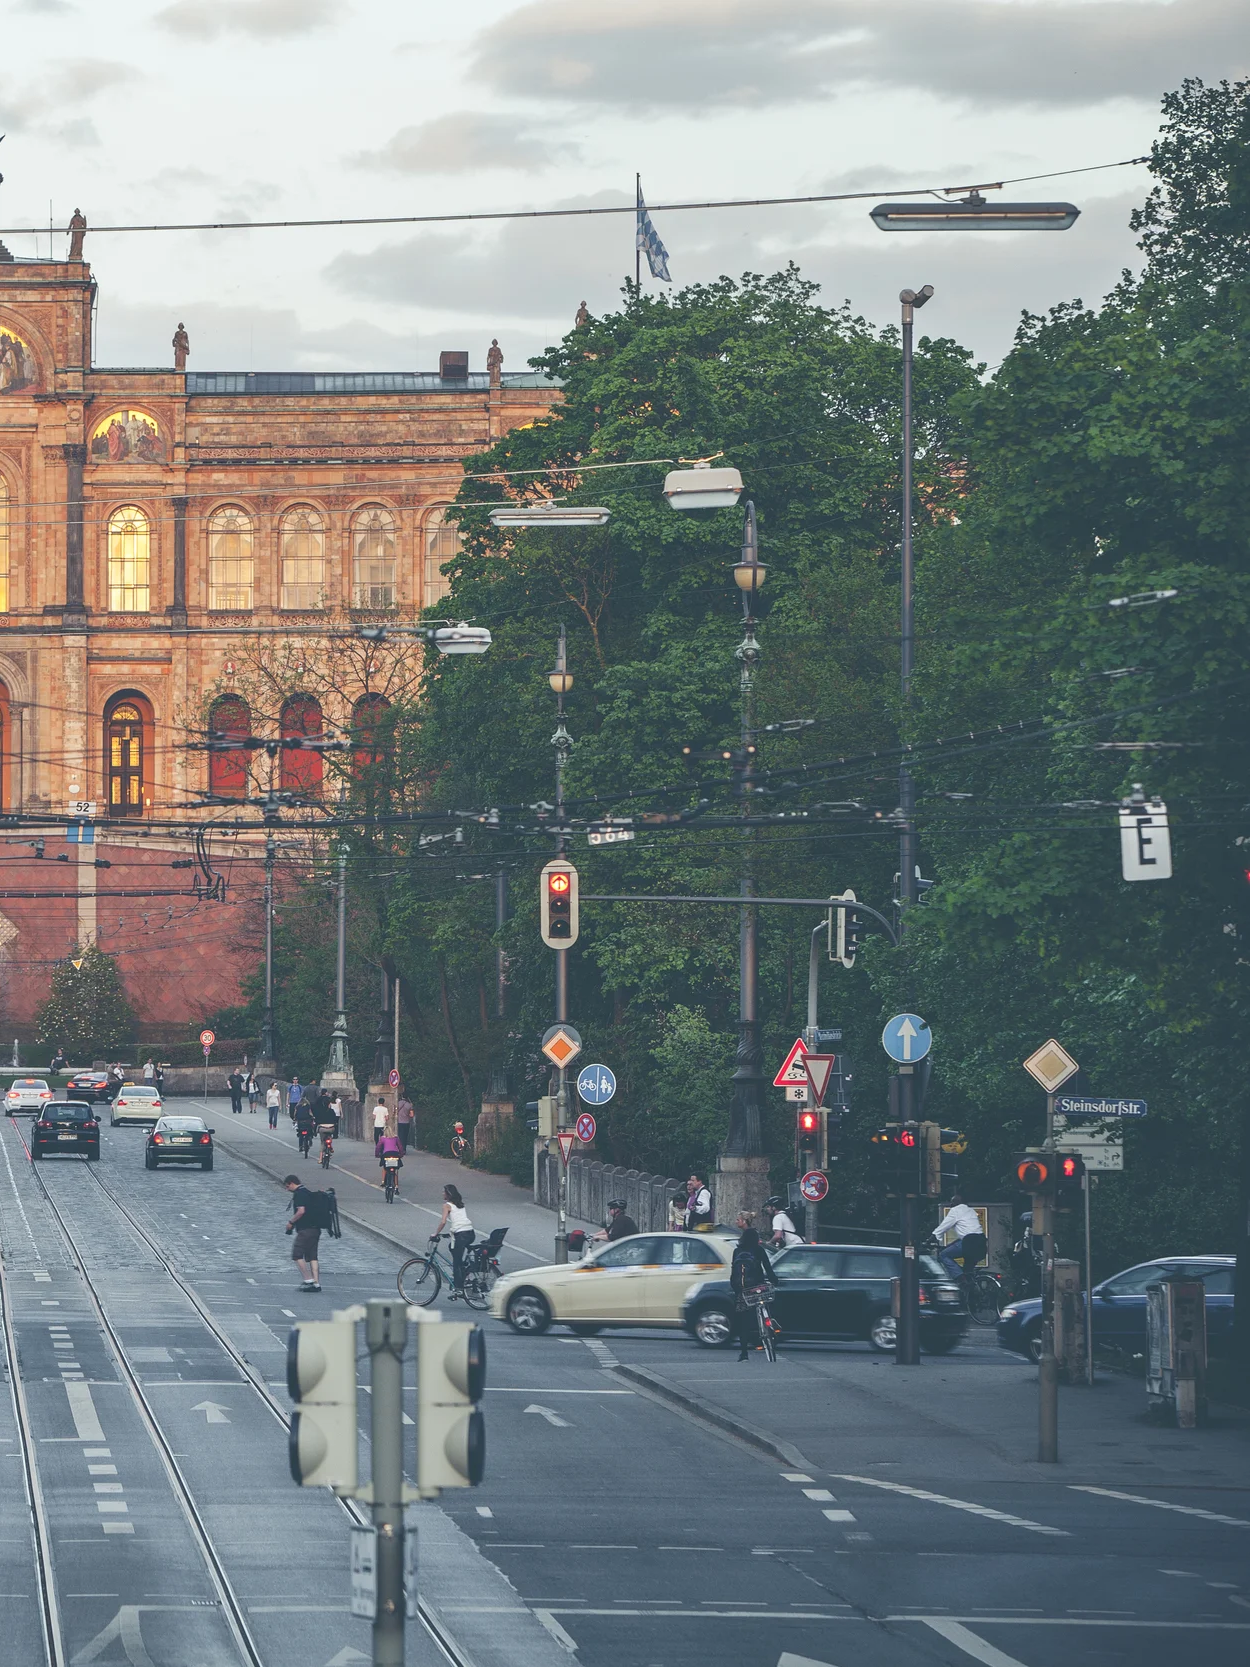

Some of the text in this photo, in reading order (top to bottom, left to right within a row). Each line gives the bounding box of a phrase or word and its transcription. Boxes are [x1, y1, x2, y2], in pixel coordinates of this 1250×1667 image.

[76, 802, 90, 812] 52
[1136, 817, 1157, 865] E
[203, 1034, 212, 1042] 30
[1061, 1098, 1142, 1116] Steinsdorfstr.
